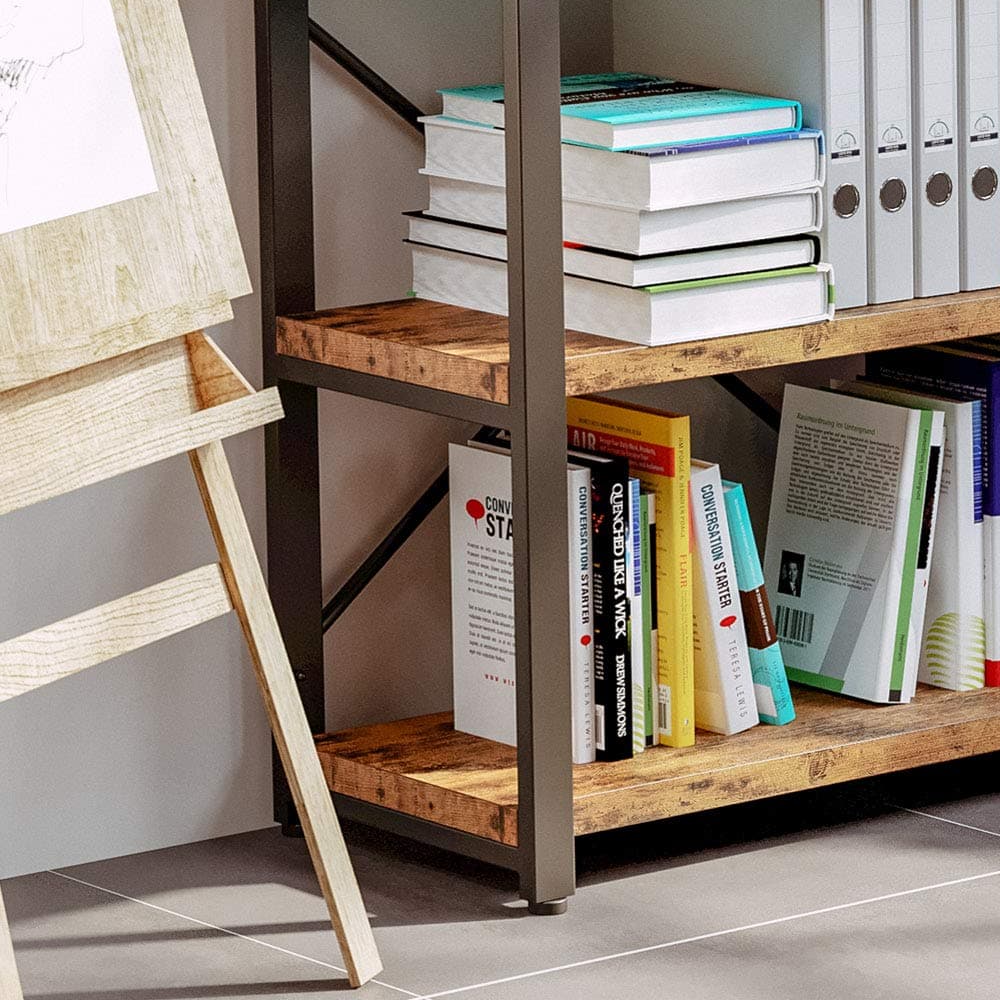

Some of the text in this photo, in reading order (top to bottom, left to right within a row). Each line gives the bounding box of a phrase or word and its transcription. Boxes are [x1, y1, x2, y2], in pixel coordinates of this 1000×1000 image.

[578, 486, 589, 571] CONVERSATION
[610, 484, 624, 556] QUENCHED
[614, 560, 624, 585] LIKE
[614, 588, 624, 598] A
[680, 554, 688, 588] FLAIR
[581, 574, 590, 624] STARTER
[615, 600, 626, 639] WICK
[700, 484, 748, 718] CONVERSATION STARTER TERESA LEWIS
